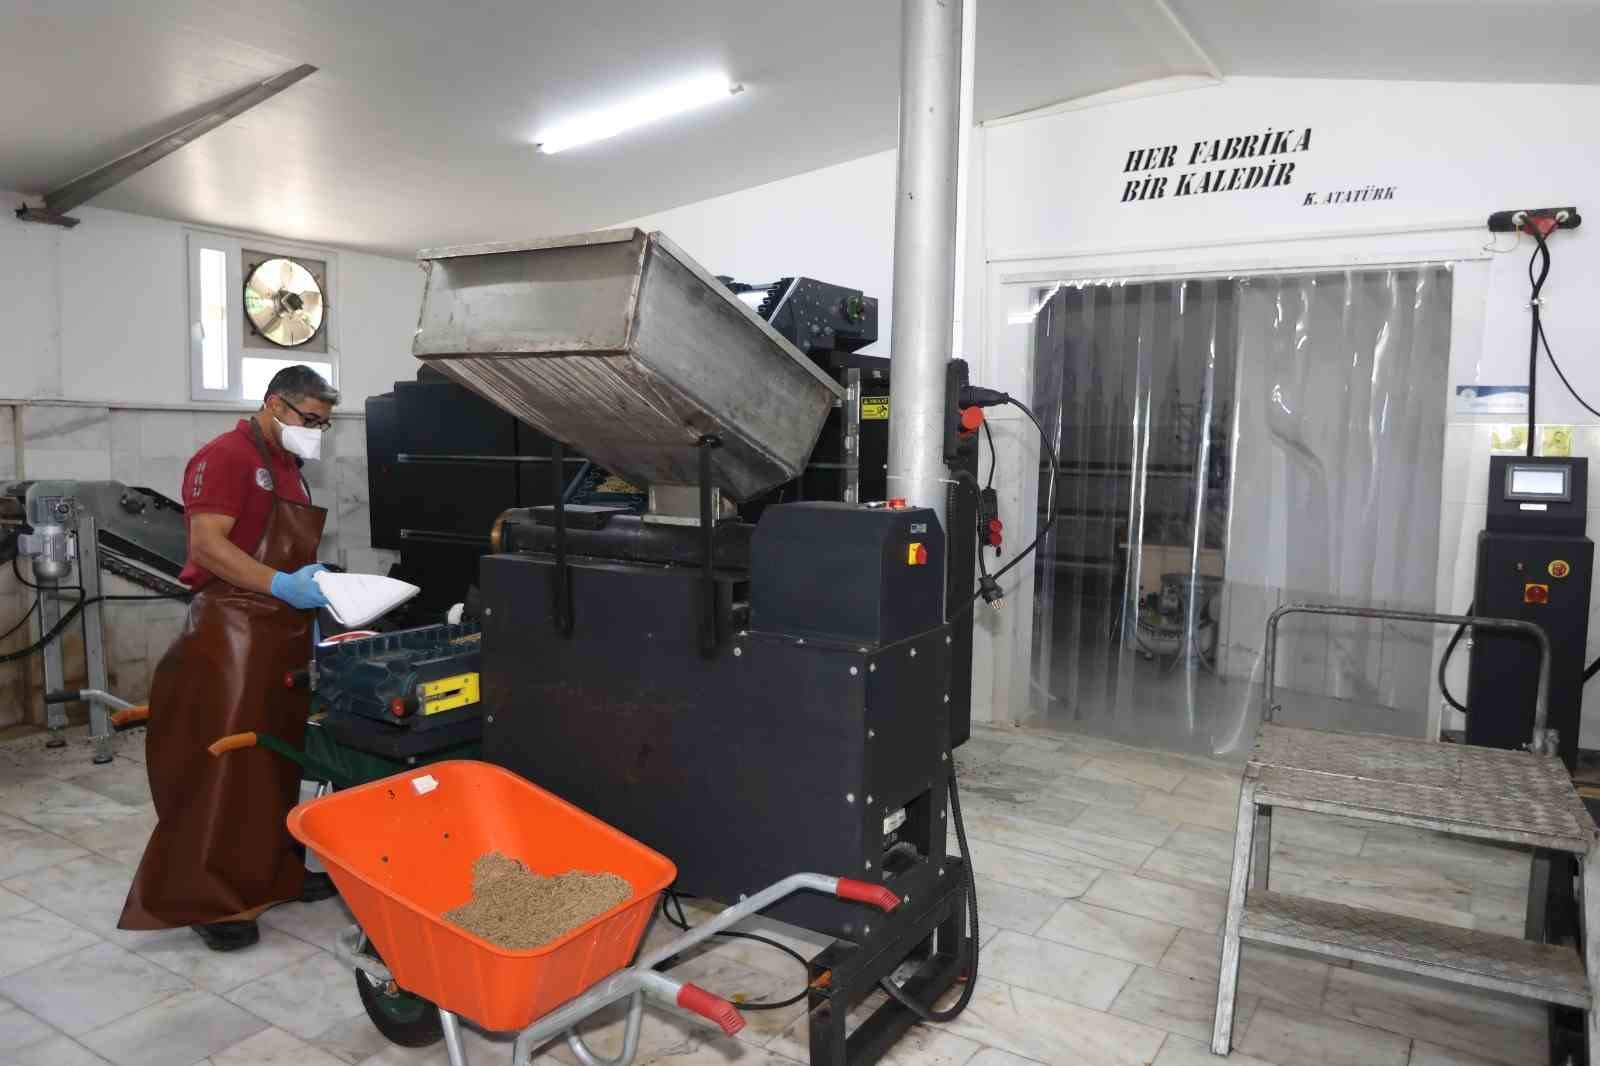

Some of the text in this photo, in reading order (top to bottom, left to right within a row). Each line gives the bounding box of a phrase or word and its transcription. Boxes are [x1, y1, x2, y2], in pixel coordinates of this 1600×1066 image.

[1123, 127, 1312, 173] HER FABRİKA
[1120, 159, 1295, 203] BİR KALEDİR
[1321, 185, 1397, 204] ATATÜRK
